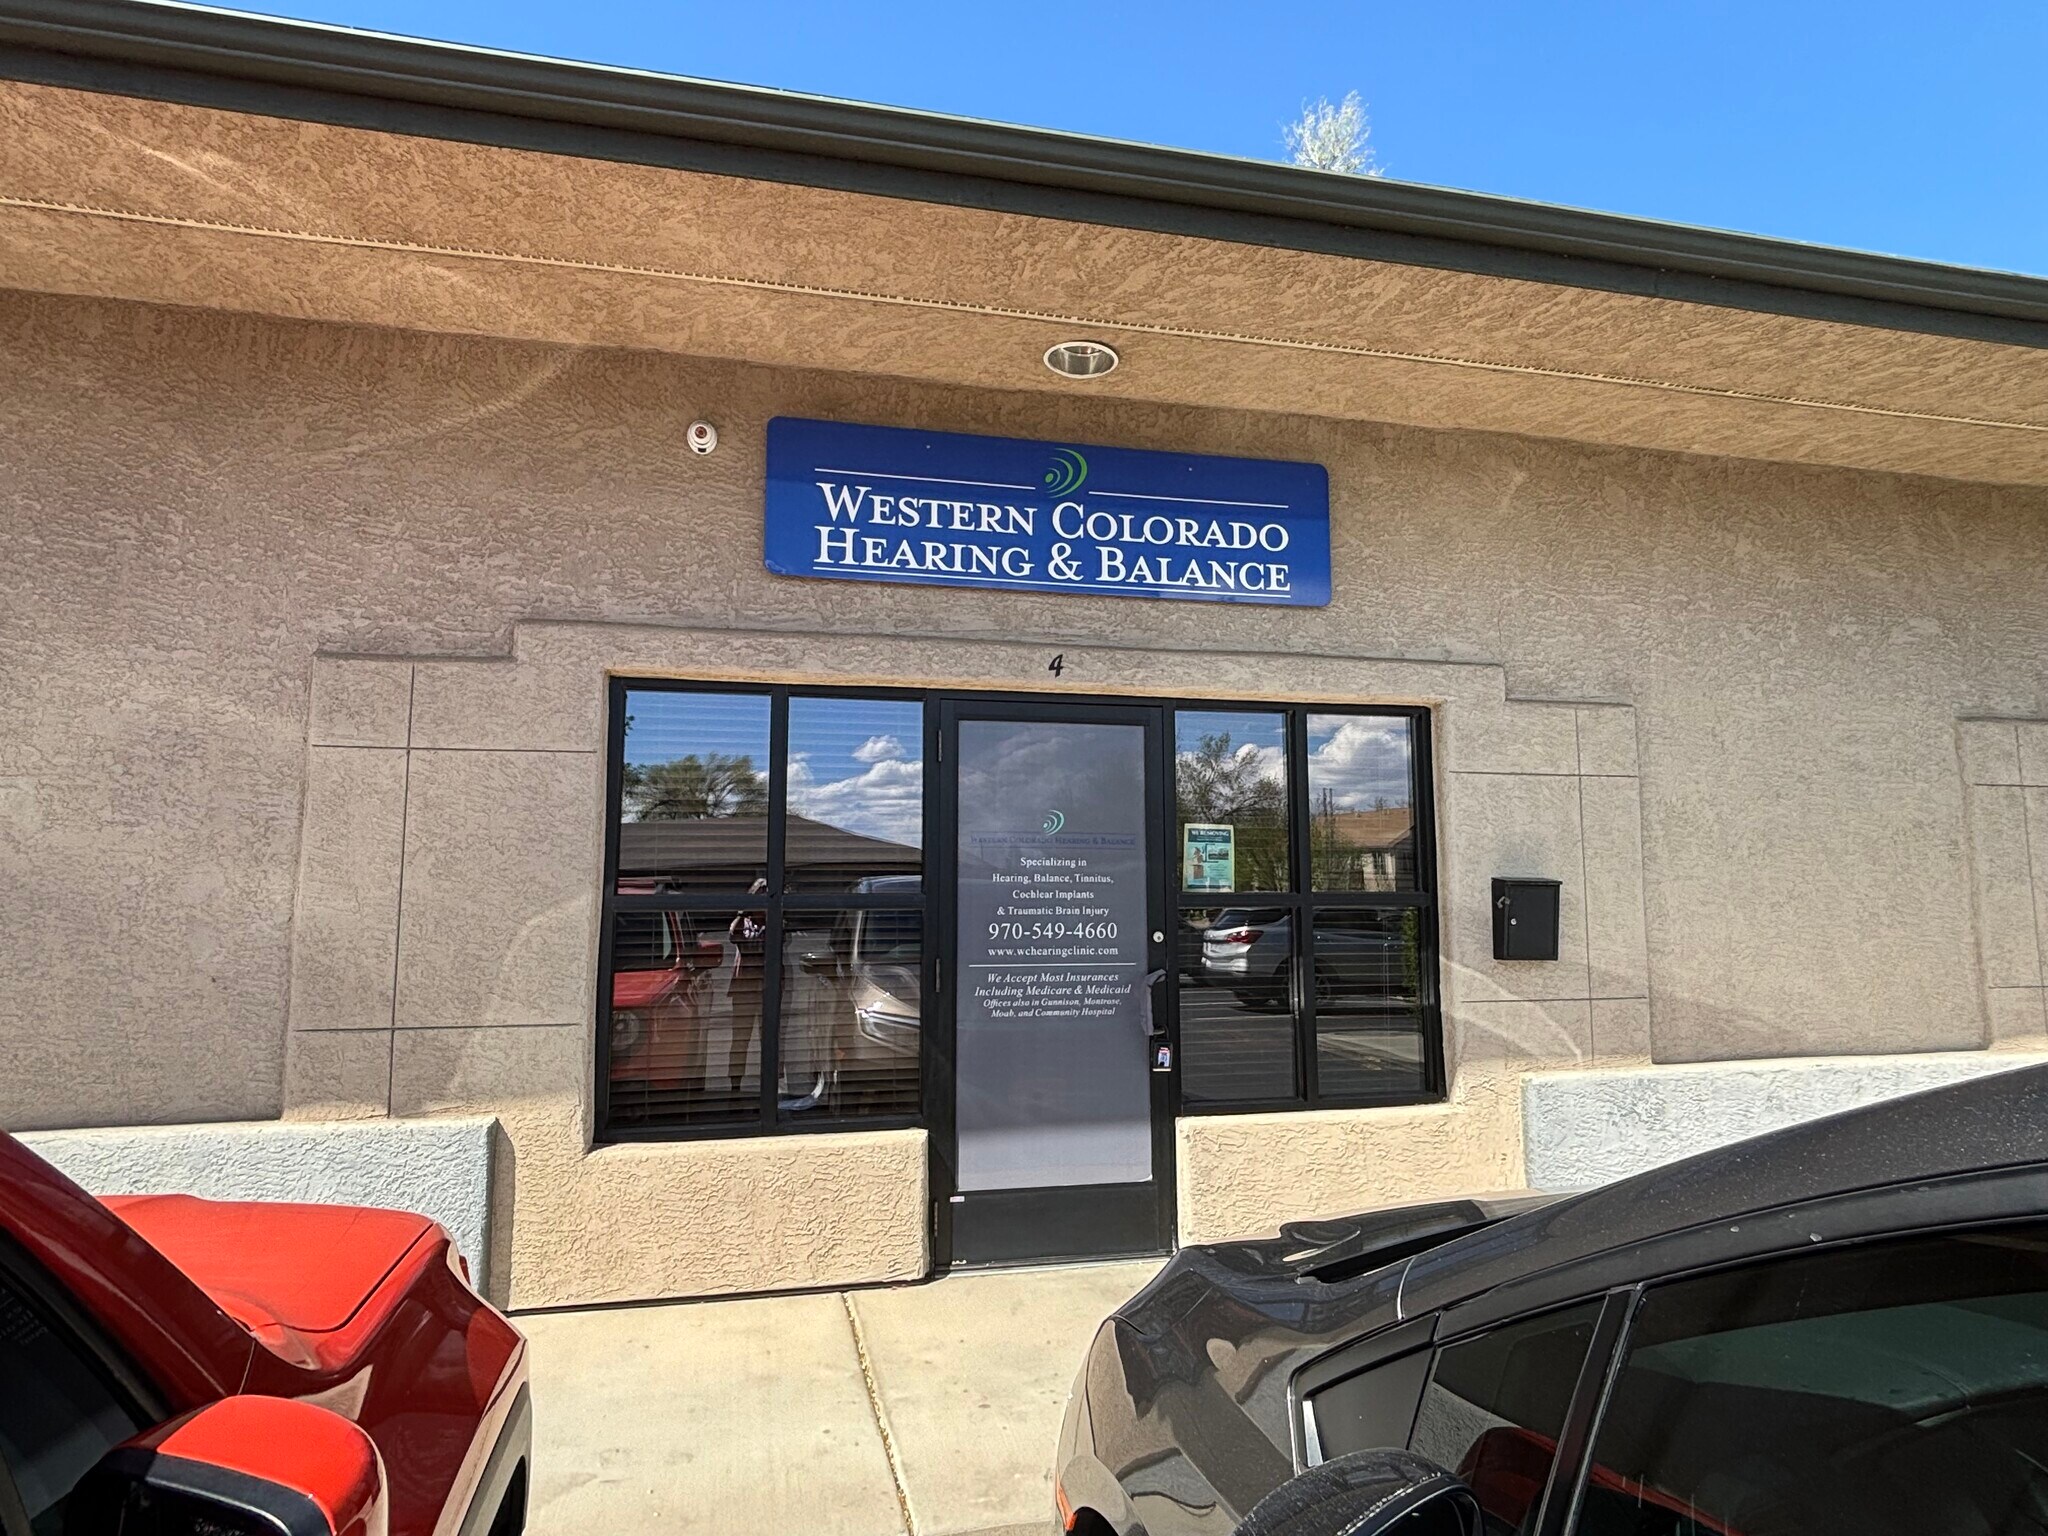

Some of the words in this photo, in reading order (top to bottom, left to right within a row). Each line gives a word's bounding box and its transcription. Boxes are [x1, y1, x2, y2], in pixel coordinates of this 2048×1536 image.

[816, 483, 1037, 536] WESTERN
[1052, 502, 1289, 552] COLORADO
[814, 526, 1035, 578] HEARING
[1048, 543, 1084, 581] &
[1096, 547, 1290, 591] BALANCE
[1049, 654, 1064, 678] 4
[1020, 857, 1076, 868] Specializing
[1078, 858, 1087, 866] in
[992, 874, 1031, 885] Hearing,
[1034, 874, 1073, 884] Balance,
[1075, 874, 1114, 884] Tinnitus,
[1013, 890, 1053, 899] Cochlear
[1055, 890, 1094, 900] Implants
[997, 907, 1005, 915] &
[1008, 907, 1053, 915] Traumatic
[1055, 907, 1080, 915] Brain
[1082, 906, 1109, 917] Injury
[988, 923, 1118, 939] 970-549-4660
[988, 946, 1118, 958] www.wchearingclinic.com
[987, 973, 1001, 983] We
[1004, 974, 1038, 985] Accept
[1040, 973, 1064, 982] Most
[1066, 973, 1119, 982] Insurances
[975, 987, 1023, 998] Including
[1026, 986, 1072, 996] Medicare
[1074, 986, 1083, 995] &
[1085, 985, 1131, 994] Medicaid
[983, 999, 1011, 1009] Offices
[1018, 1009, 1033, 1017] and
[1035, 1008, 1080, 1018] Community
[1082, 1008, 1115, 1017] Hospital
